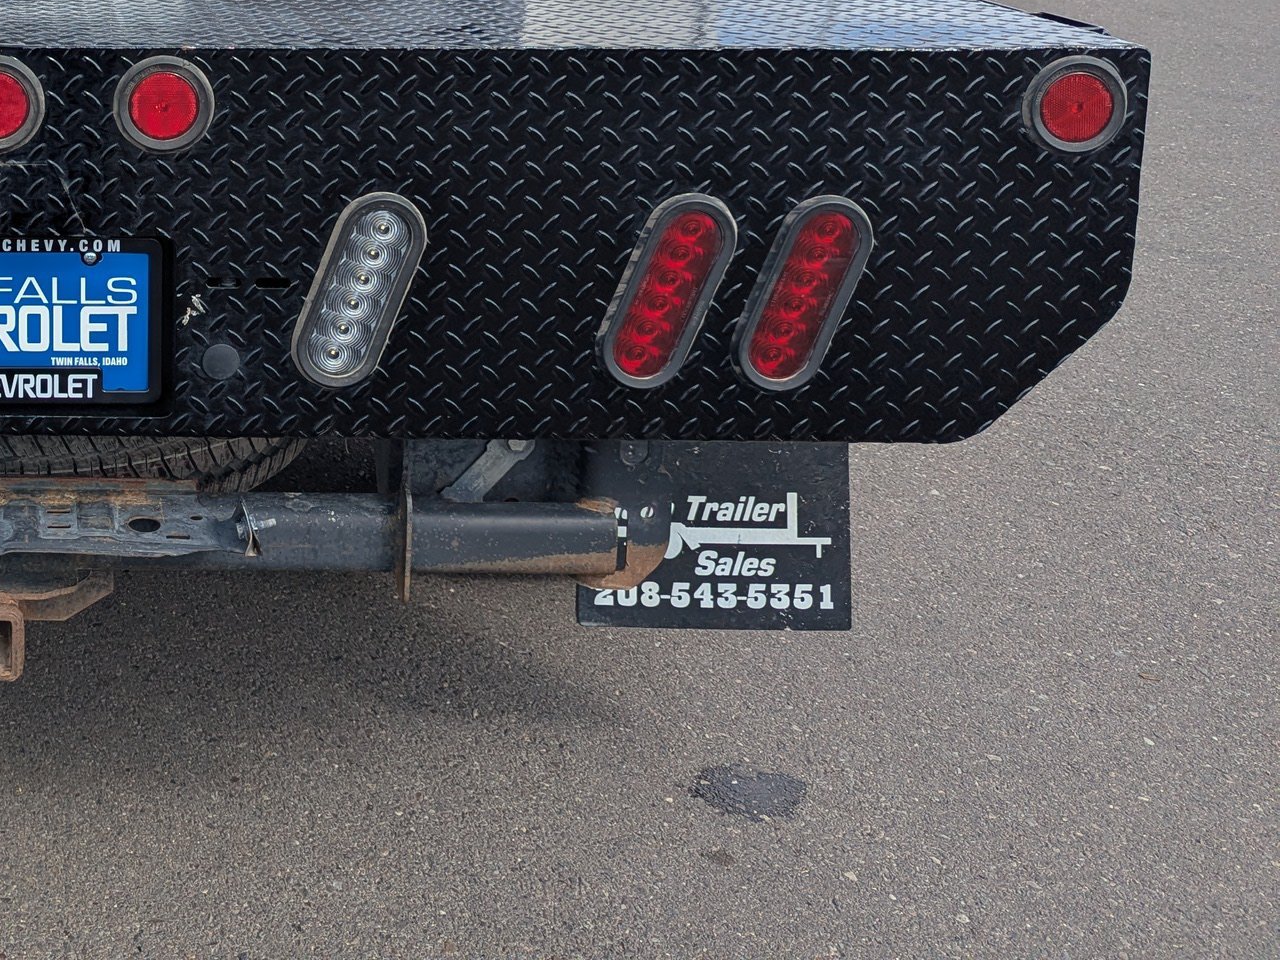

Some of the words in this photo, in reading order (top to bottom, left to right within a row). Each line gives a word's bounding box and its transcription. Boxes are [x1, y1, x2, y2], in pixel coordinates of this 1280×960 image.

[50, 356, 73, 366] TWIN
[74, 356, 101, 368] FALLS,
[102, 356, 128, 366] IDAHO
[686, 495, 786, 523] Trailer
[694, 550, 777, 577] Sales
[593, 581, 834, 610] 208-543-5351
